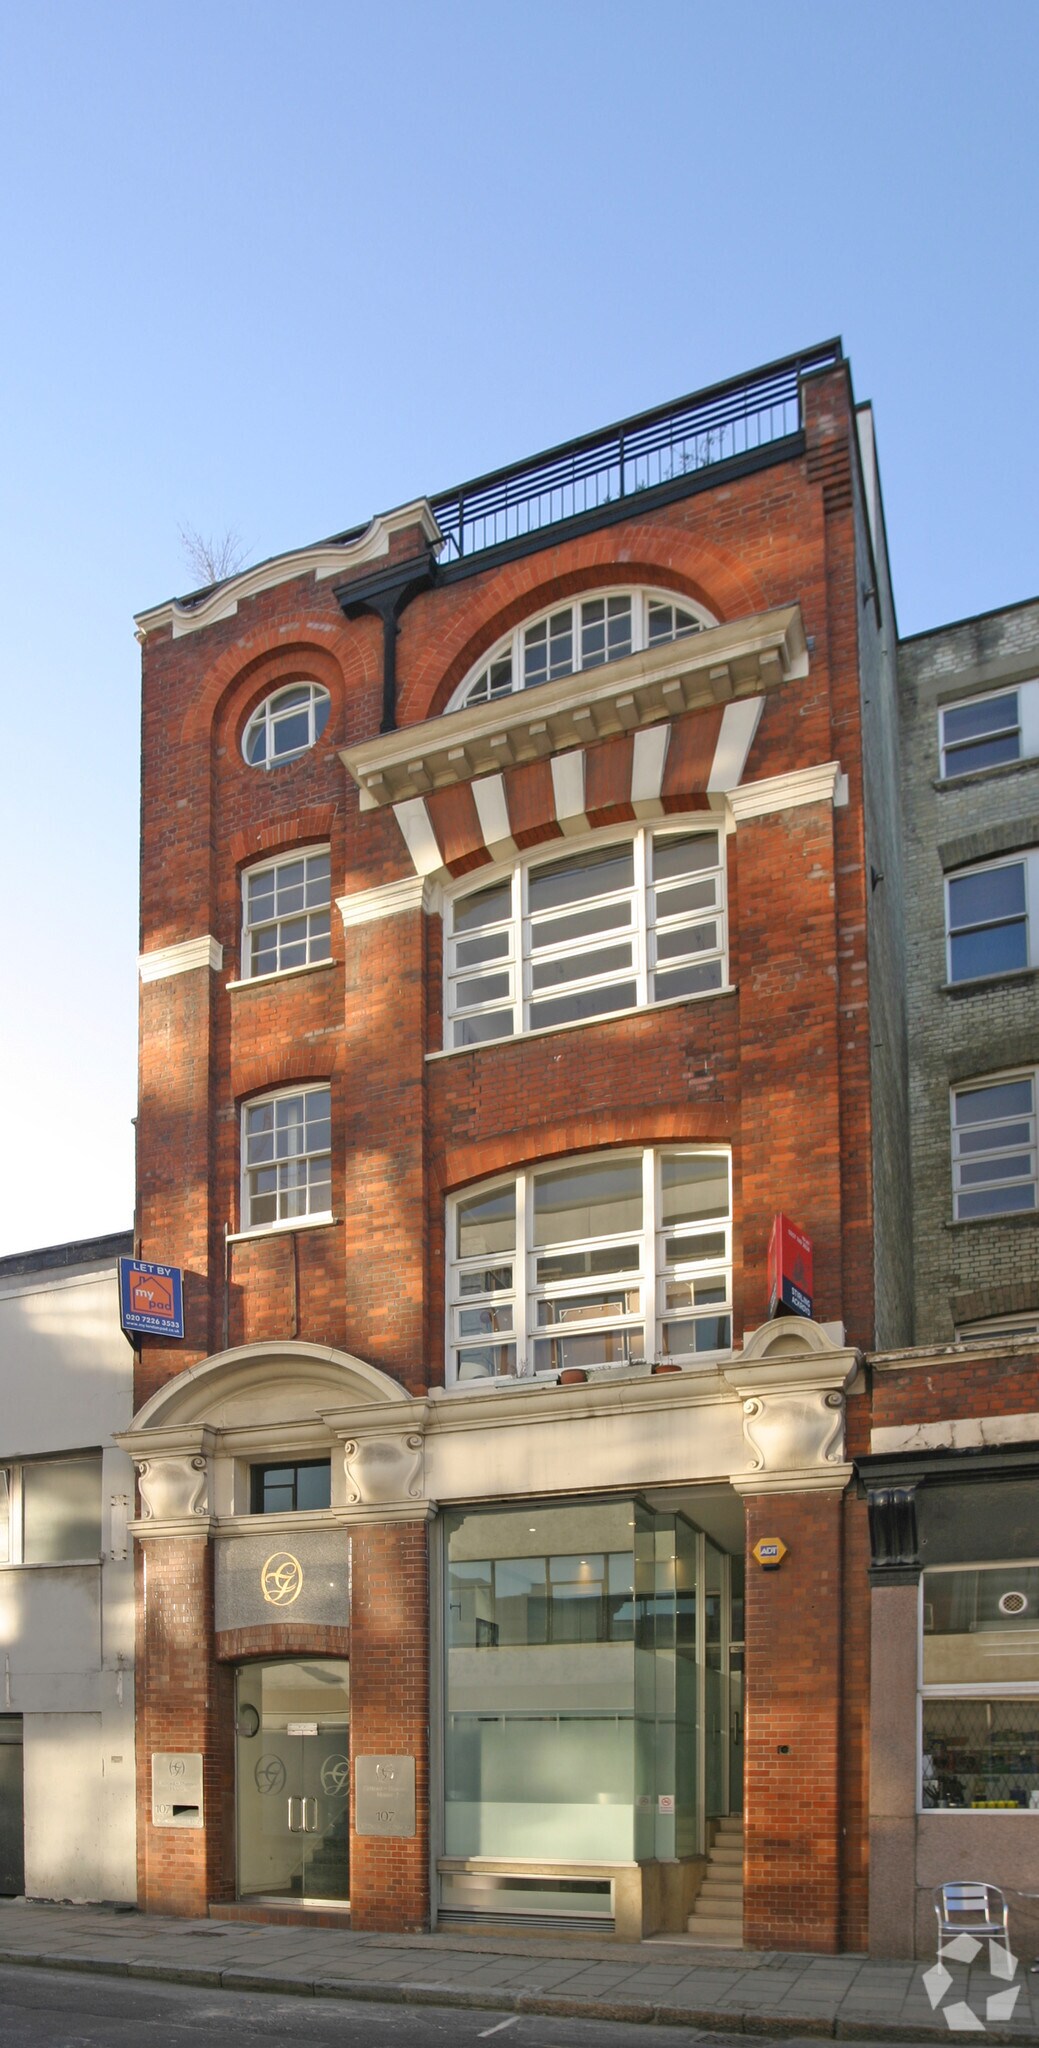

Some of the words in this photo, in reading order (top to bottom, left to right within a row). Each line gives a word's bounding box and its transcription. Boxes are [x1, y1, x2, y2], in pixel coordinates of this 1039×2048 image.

[133, 1262, 154, 1273] LET
[157, 1266, 171, 1276] BY
[135, 1289, 154, 1300] my
[149, 1300, 172, 1311] pad
[126, 1313, 140, 1322] 020
[141, 1316, 160, 1325] 7226
[161, 1319, 180, 1329] 3533
[761, 1546, 777, 1555] ADT
[156, 1804, 171, 1814] 107
[376, 1811, 395, 1821] 107
